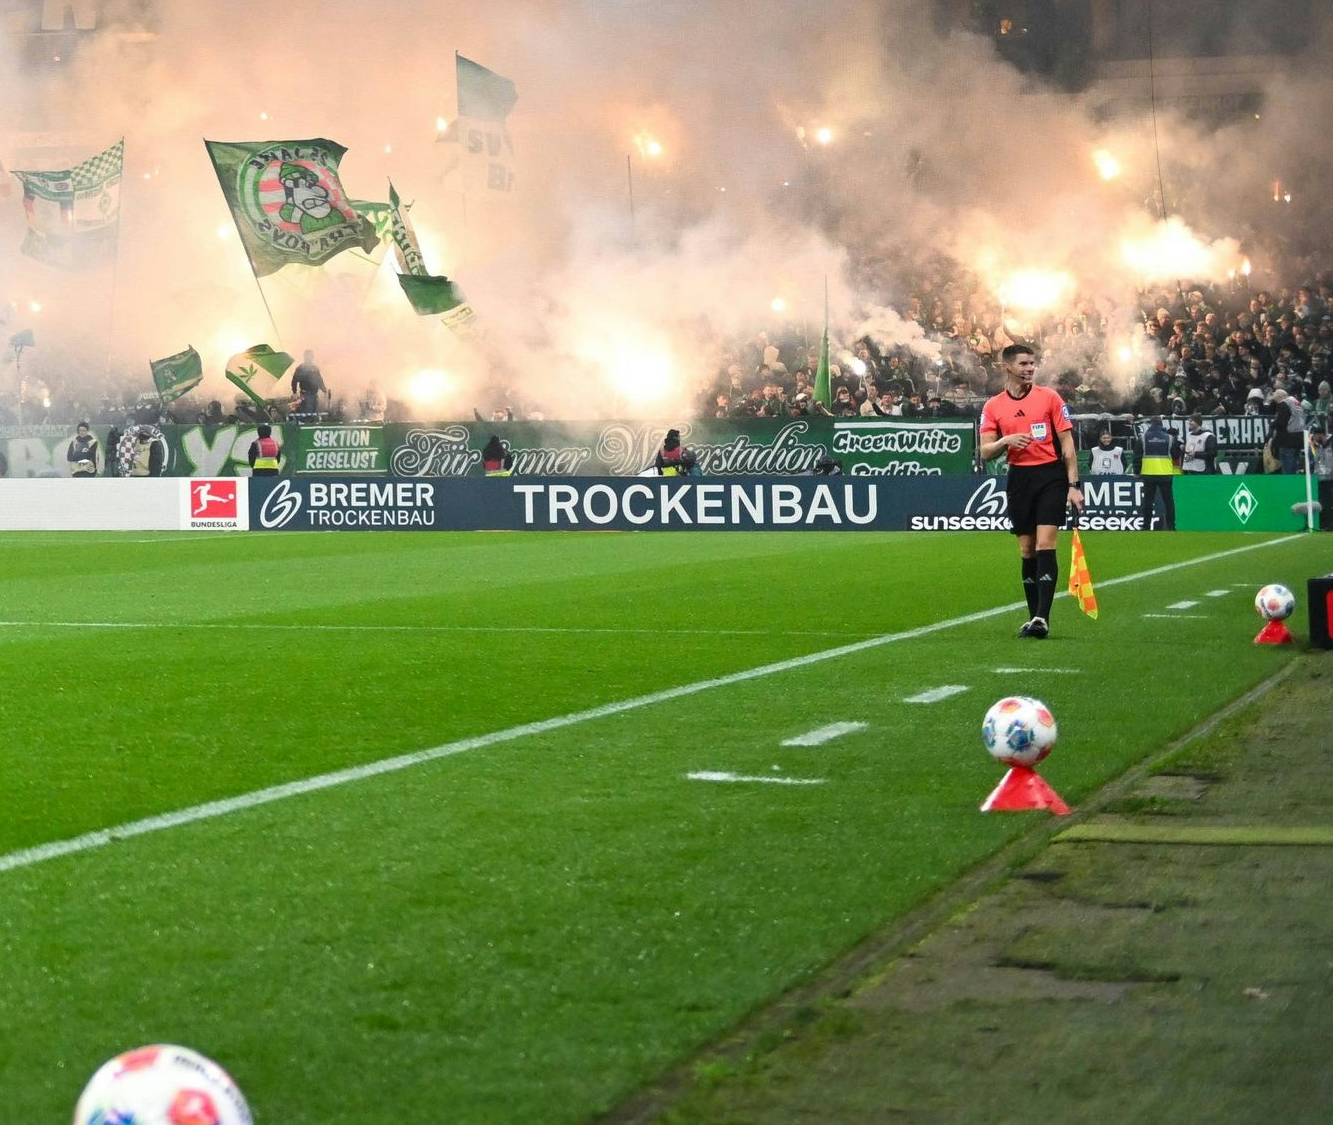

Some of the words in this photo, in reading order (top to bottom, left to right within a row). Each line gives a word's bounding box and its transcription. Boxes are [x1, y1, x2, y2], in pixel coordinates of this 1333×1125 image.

[313, 429, 370, 448] SEKTION
[305, 450, 379, 470] REISELUST
[309, 483, 435, 507] BREMER
[513, 484, 878, 525] TROCKENBAU
[306, 510, 435, 526] TROCKENBAU
